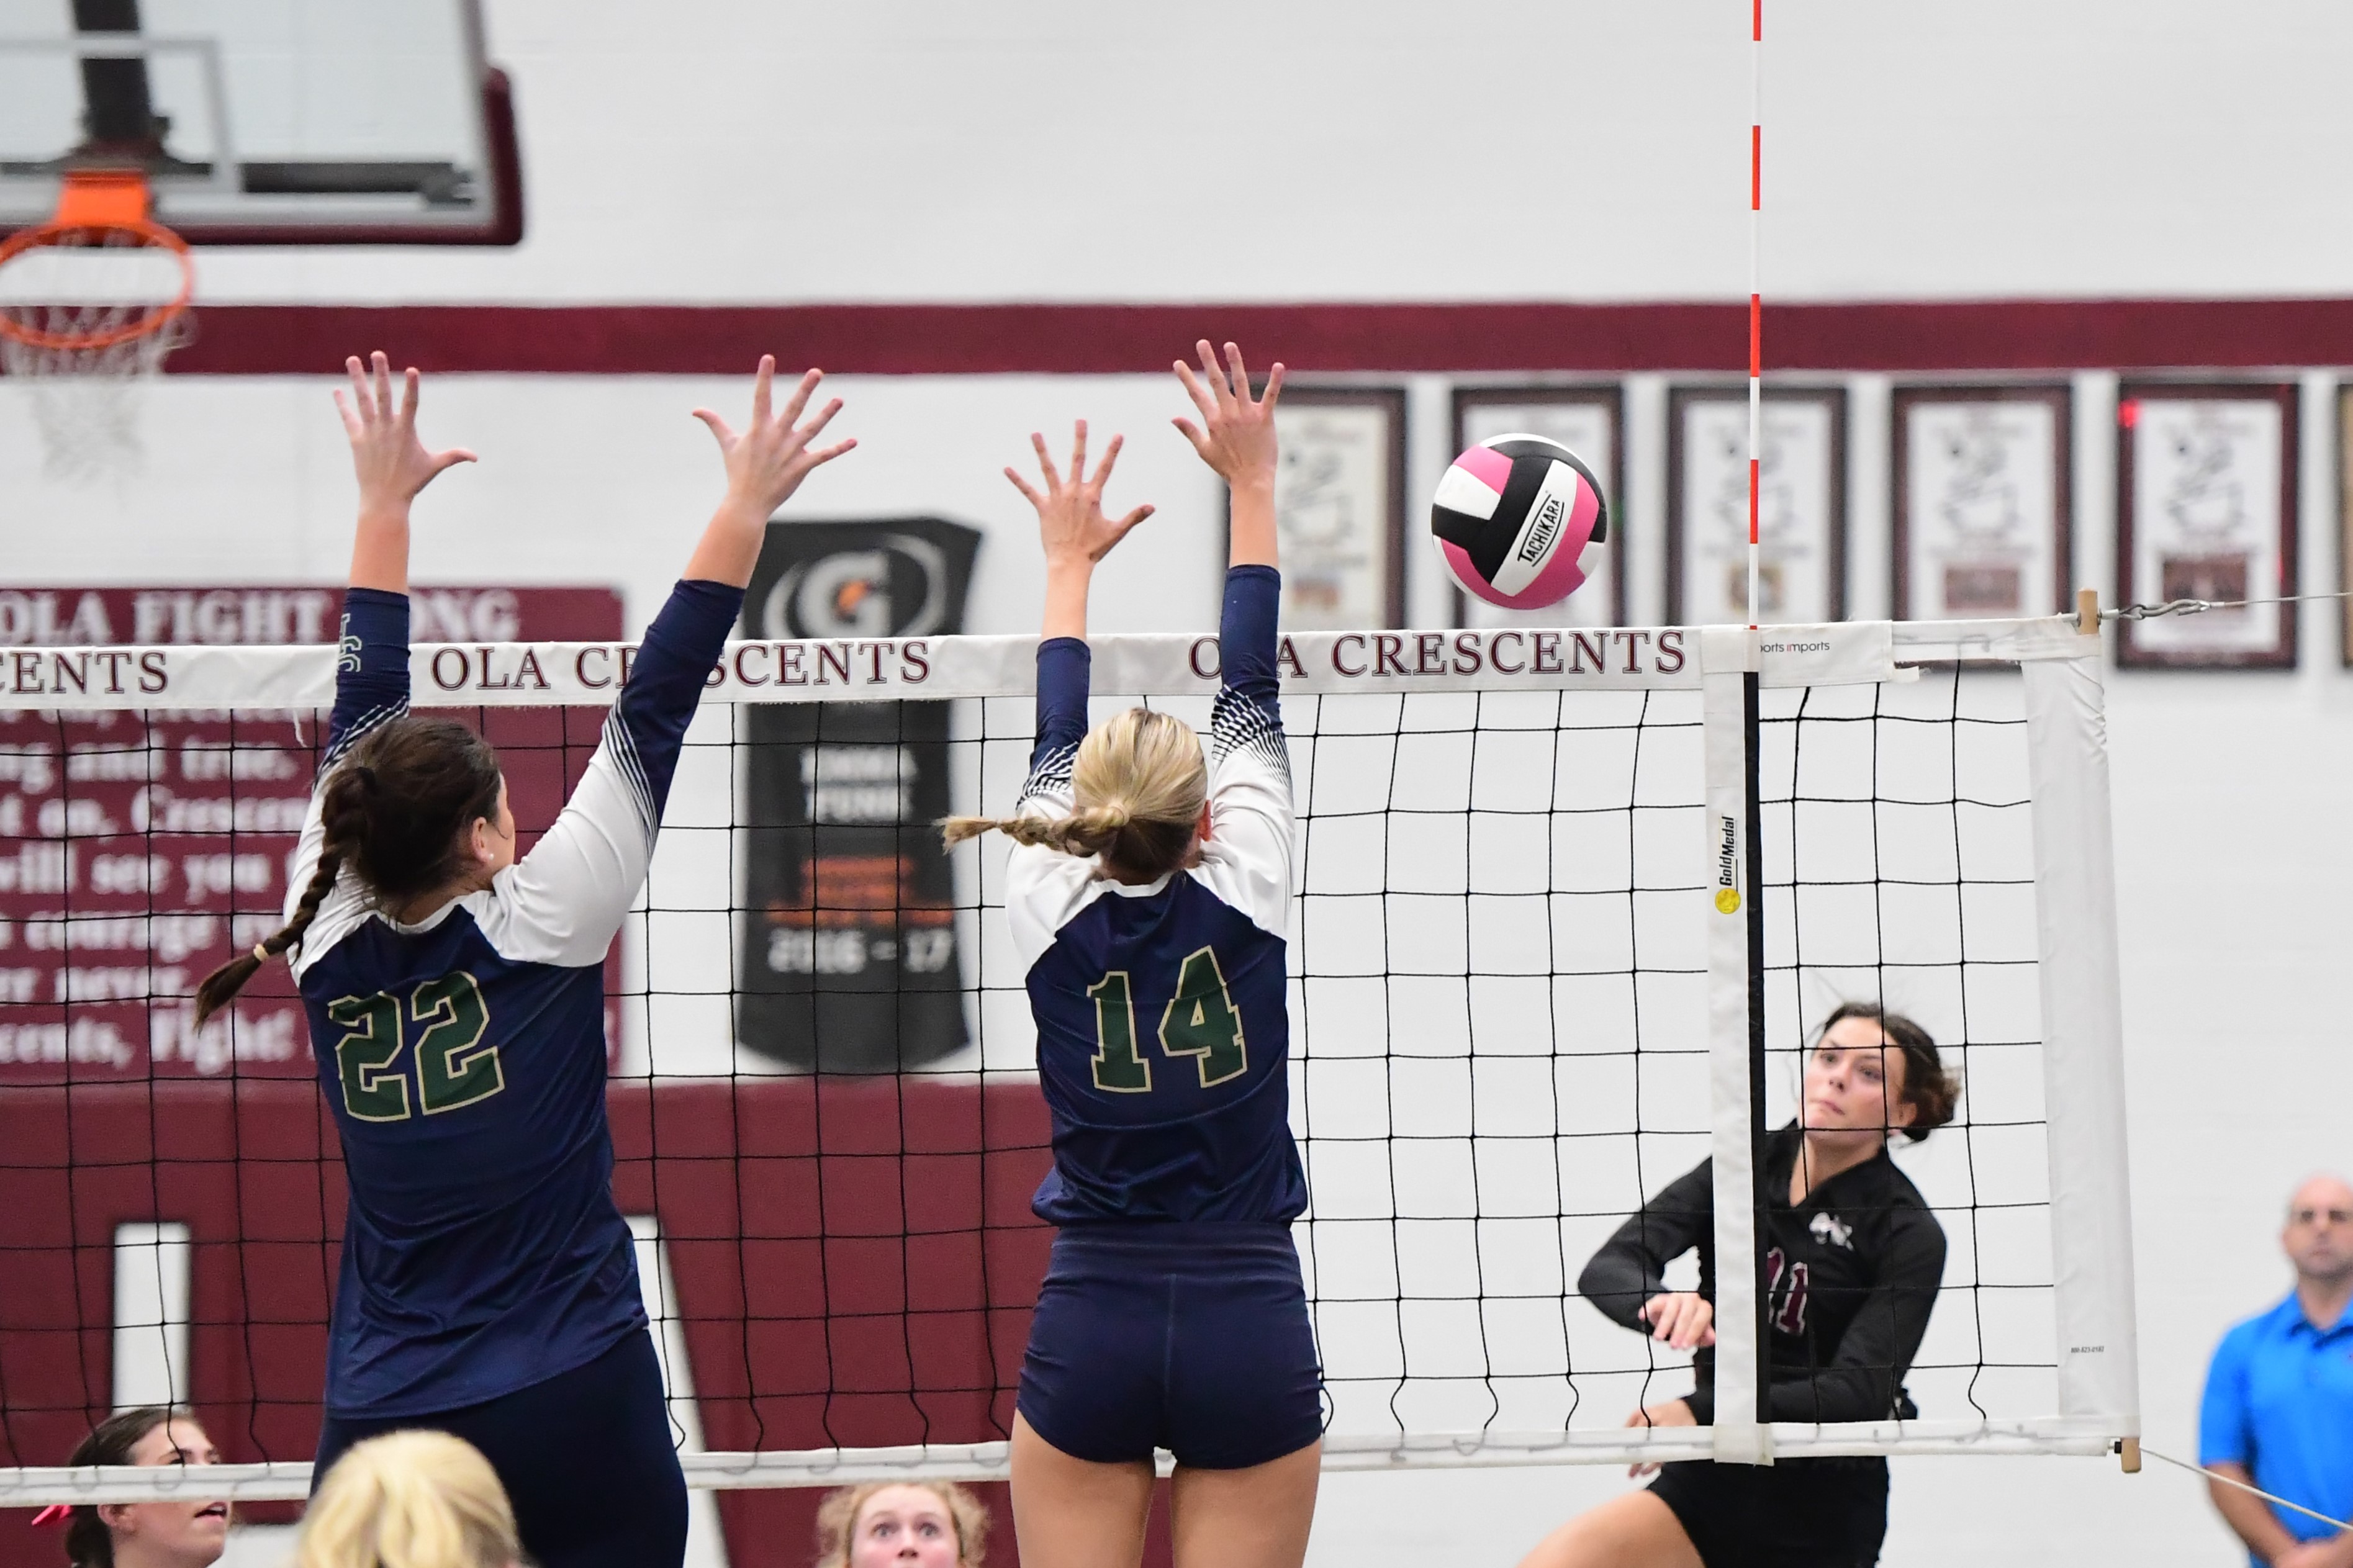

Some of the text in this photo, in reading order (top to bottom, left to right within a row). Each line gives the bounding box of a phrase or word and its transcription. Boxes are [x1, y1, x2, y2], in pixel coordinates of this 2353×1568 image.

[1517, 498, 1561, 562] TACHIKARA
[132, 588, 329, 644] FIGHT
[0, 650, 168, 694] ENTS
[430, 646, 551, 691] OLA
[1188, 629, 1686, 680] OA CRESCENTS
[1760, 641, 1830, 653] orts imports
[905, 927, 952, 974] 17
[1086, 945, 1248, 1093] 14
[327, 970, 505, 1122] 22
